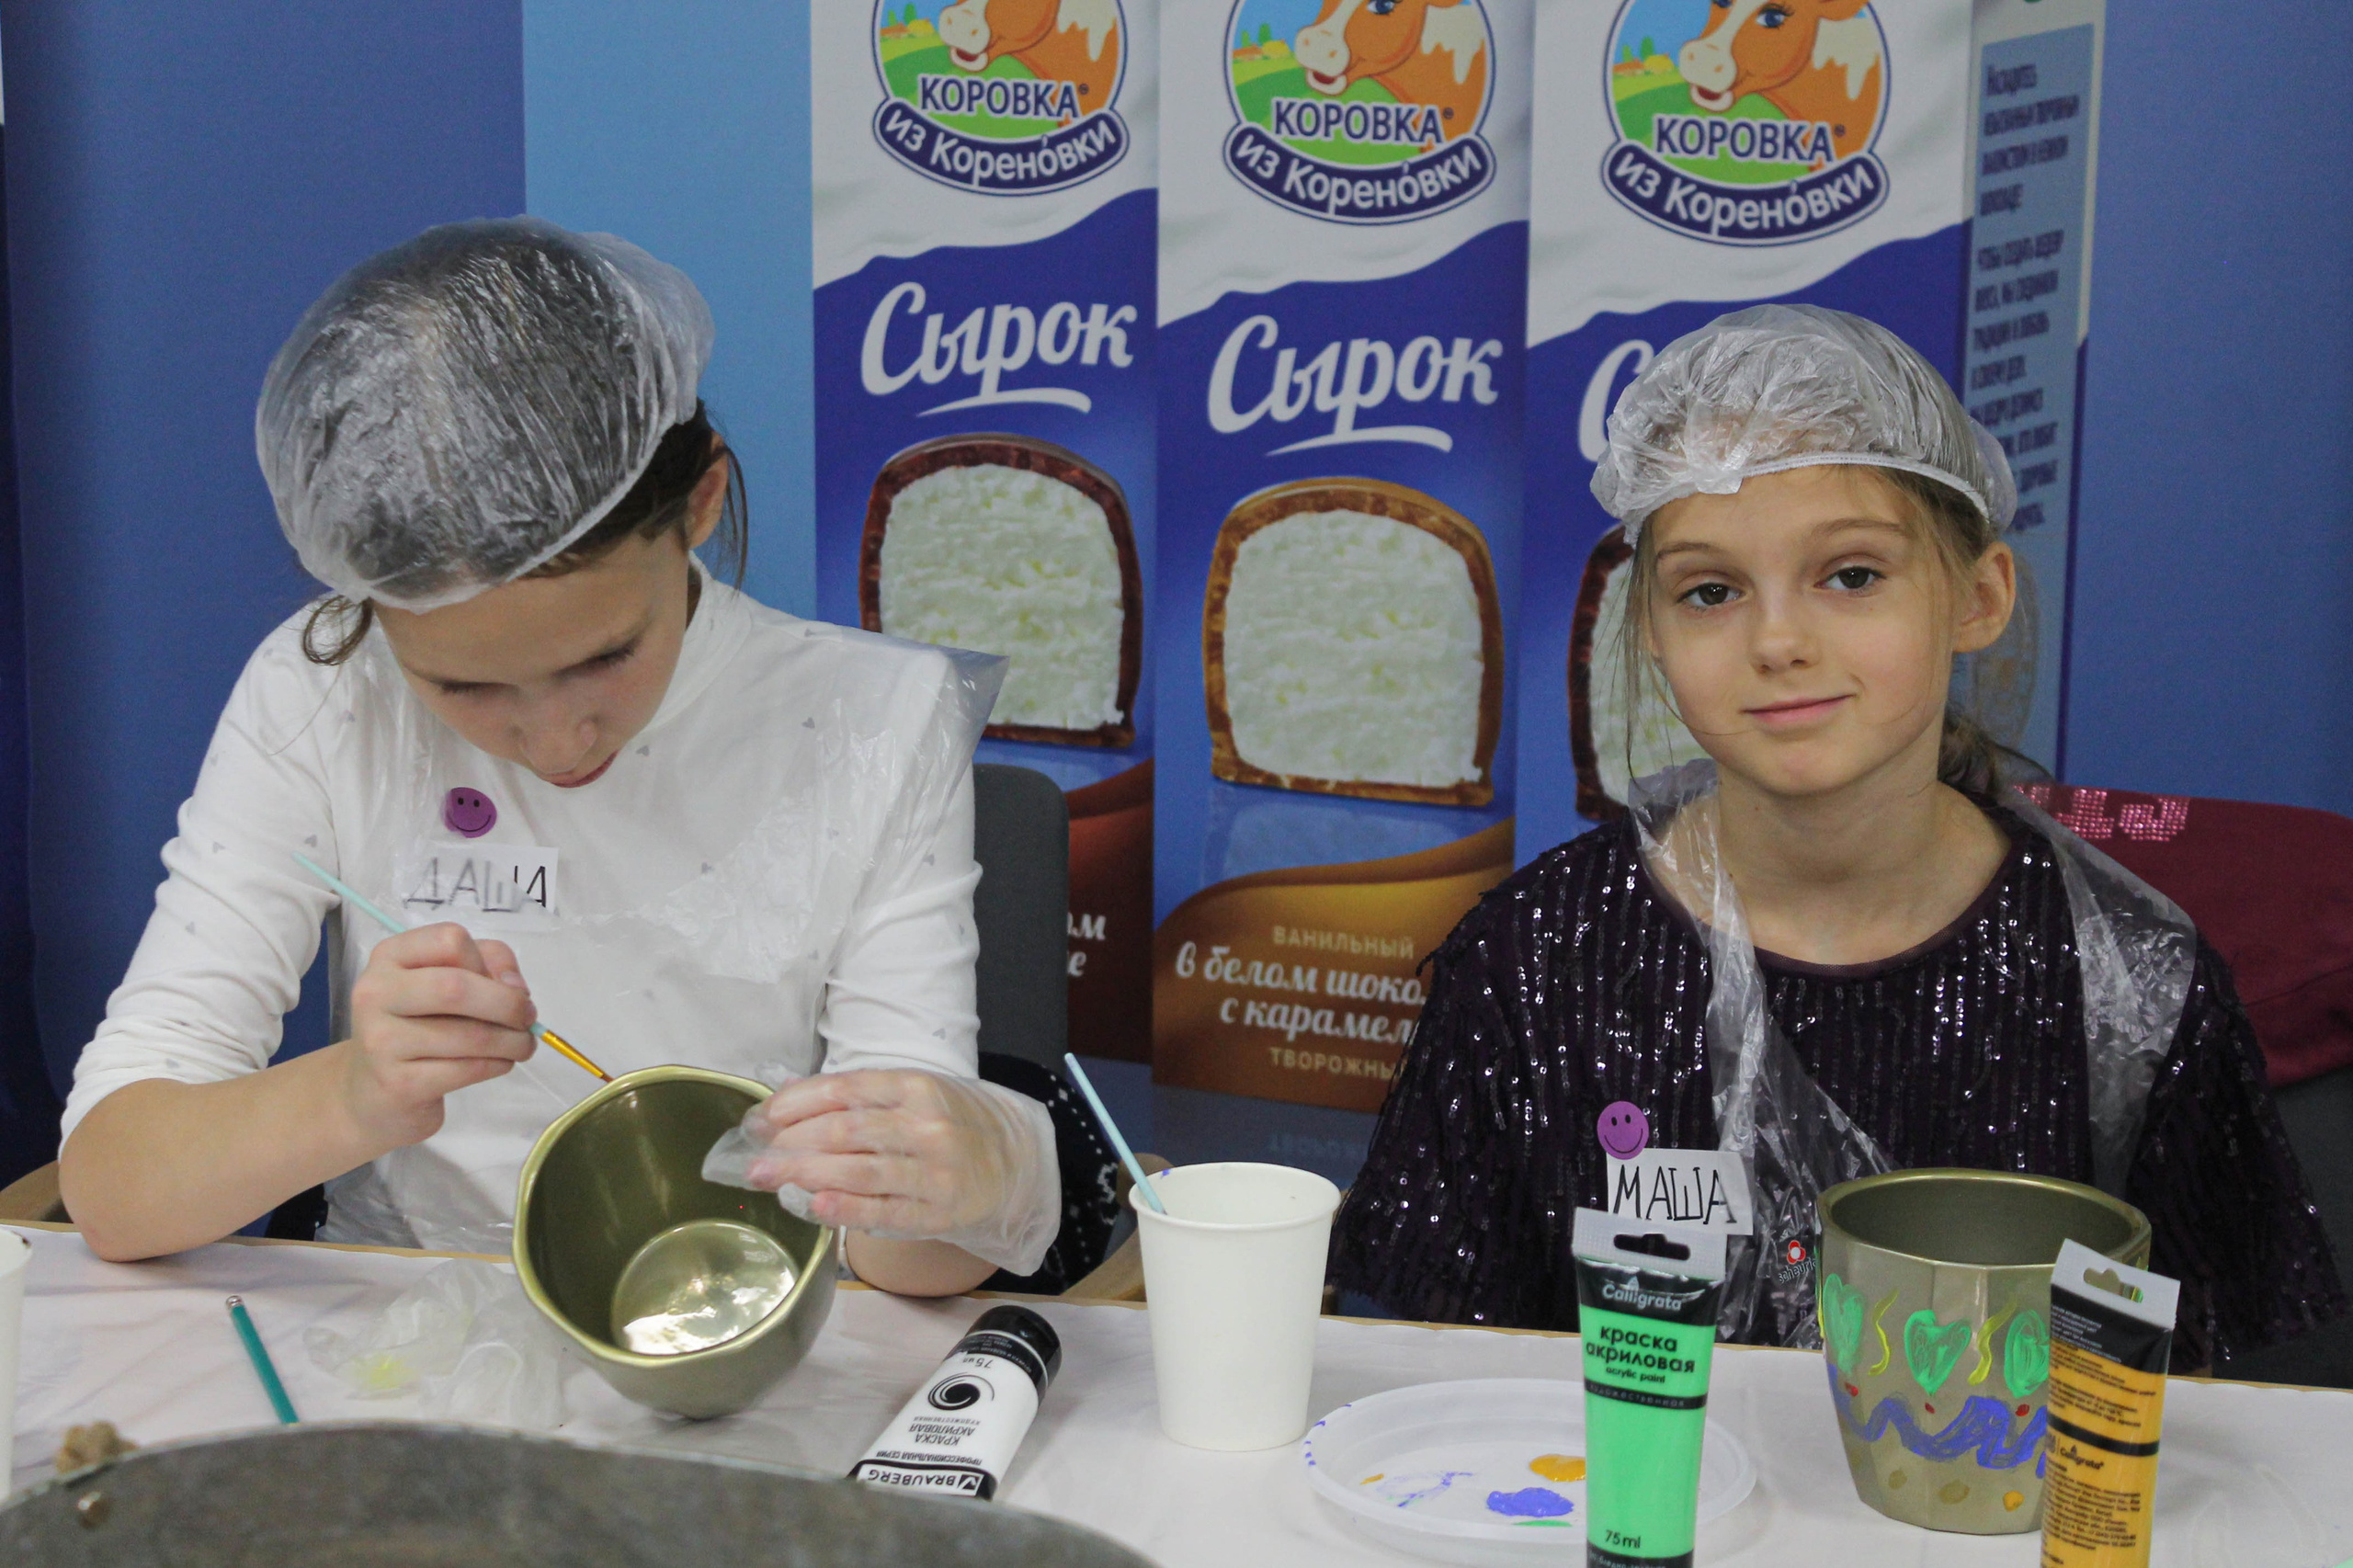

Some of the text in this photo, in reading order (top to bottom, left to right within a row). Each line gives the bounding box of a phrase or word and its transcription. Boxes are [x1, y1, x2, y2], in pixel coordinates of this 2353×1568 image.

[920, 76, 1080, 119] КОРОВКА
[885, 109, 926, 152] из
[1274, 100, 1444, 143] КОРОВКА
[1655, 118, 1834, 163] КОРОВКА
[1236, 134, 1280, 179] из
[1615, 152, 1661, 199] из
[859, 281, 1138, 398] Сырок
[1207, 314, 1504, 436] Сырок
[403, 857, 548, 914] ДАША
[1272, 925, 1415, 960] ВАНИЛЬНЫЙ
[1175, 940, 1427, 1006] в белом шоко
[1219, 996, 1415, 1044] с карамел
[1268, 1046, 1398, 1080] ТВОРОЖНЫ
[1613, 1164, 1738, 1225] МАША
[1602, 1278, 1683, 1312] Calligrata
[1586, 1341, 1696, 1374] акриловая
[1600, 1325, 1678, 1353] краска
[975, 1358, 995, 1369] 75
[1606, 1366, 1666, 1384] acrylic paint
[908, 1423, 976, 1437] АКРИЛОВАЯ
[915, 1433, 961, 1447] КРАСКА
[876, 1450, 983, 1466] ПРОФЕССИОНАЛЬНАЯ СЕРИЯ
[867, 1469, 958, 1487] BRAUBERG
[1605, 1529, 1642, 1549] 75 ml
